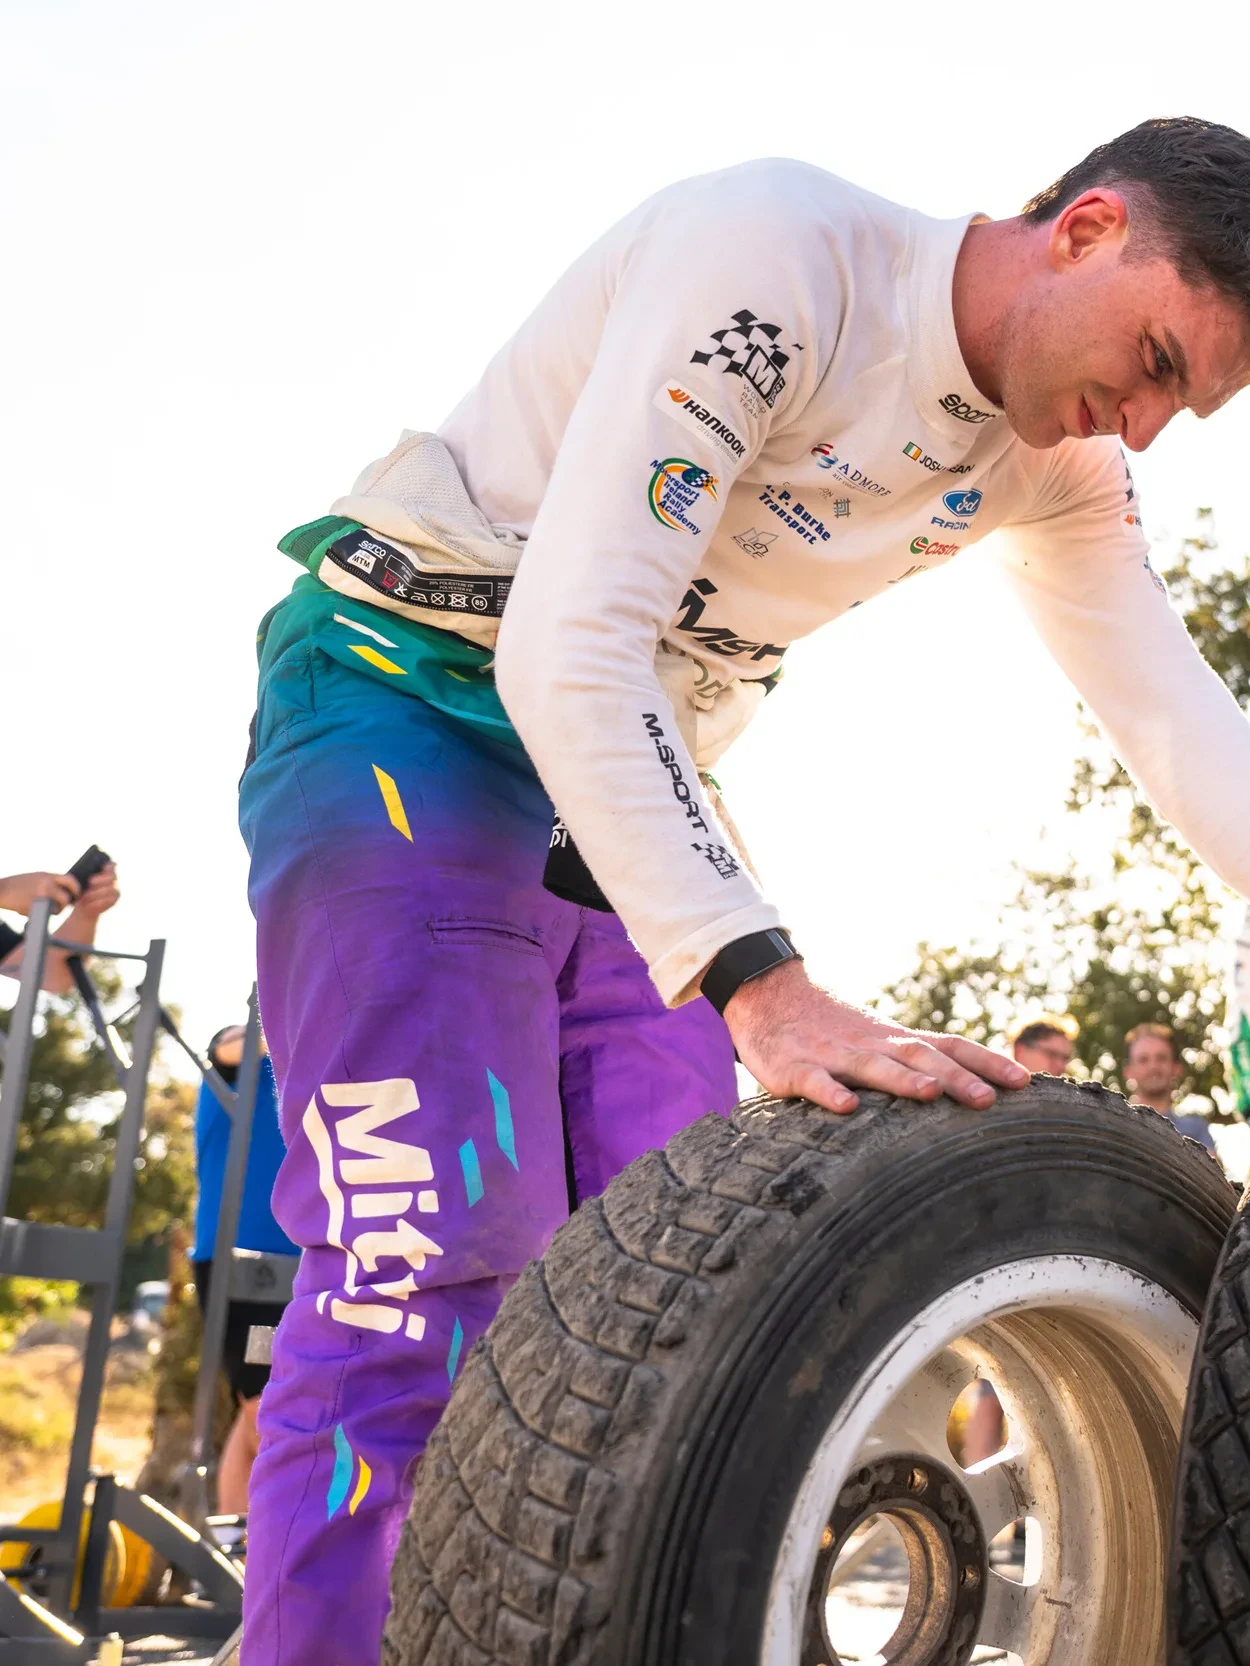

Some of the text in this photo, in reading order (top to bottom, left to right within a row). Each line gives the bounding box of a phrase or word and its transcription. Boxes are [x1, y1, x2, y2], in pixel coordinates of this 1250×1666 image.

[650, 459, 700, 500] Motorsport
[664, 480, 695, 507] Ireland
[838, 463, 892, 496] ADMORE
[657, 500, 701, 536] Academy
[663, 492, 686, 513] Rally
[759, 492, 817, 545] Transport
[792, 503, 831, 541] Burke
[931, 517, 972, 530] RACIN
[352, 554, 371, 568] MTM
[641, 713, 709, 834] M-SPORT
